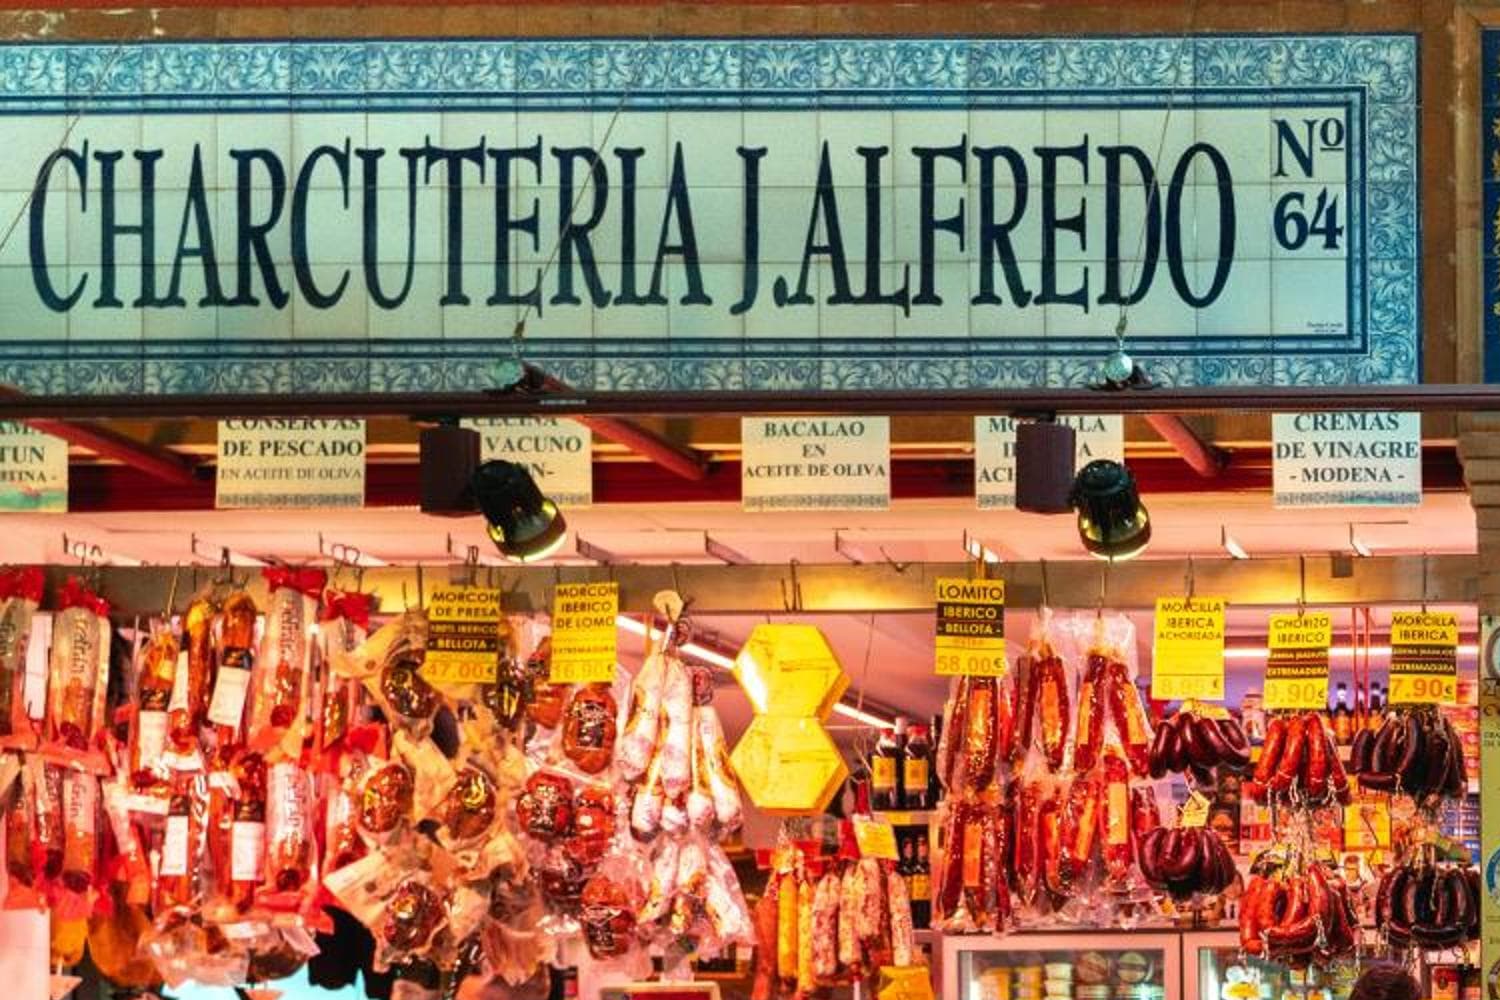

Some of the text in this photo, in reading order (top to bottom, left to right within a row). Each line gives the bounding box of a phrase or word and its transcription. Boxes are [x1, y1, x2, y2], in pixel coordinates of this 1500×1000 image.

[1272, 187, 1344, 251] 64
[28, 135, 713, 319] CHARCUTERIA
[1294, 412, 1399, 431] CREMAS
[764, 421, 866, 438] BACALAO
[223, 440, 363, 457] DE PESCADO
[485, 436, 583, 454] VACUNO
[802, 444, 827, 457] EN
[1275, 441, 1419, 458] DE VINAGRE
[221, 467, 362, 480] EN ACEITE DE OLIVA
[744, 463, 886, 478] ACEITE DE OLIVA
[1302, 468, 1390, 482] MODENA
[431, 592, 499, 602] MORCON
[557, 586, 618, 598] MORCON
[939, 584, 1003, 600] LOMITO
[435, 607, 497, 617] DE PRESA
[561, 601, 613, 613] IBERICO
[944, 605, 997, 619] IBERICO
[1161, 601, 1221, 614] MORCILLA
[556, 616, 616, 629] DE LOMO
[1166, 617, 1215, 629] IBERICA
[1274, 617, 1329, 630] CHORIZO
[1391, 615, 1457, 627] MORCILLA
[945, 623, 994, 634] BELLOTA
[1158, 631, 1221, 641] ACHORIZADA
[1277, 632, 1325, 643] IBERICO
[1399, 630, 1449, 641] IBERICA
[437, 639, 488, 649] BELLOTA
